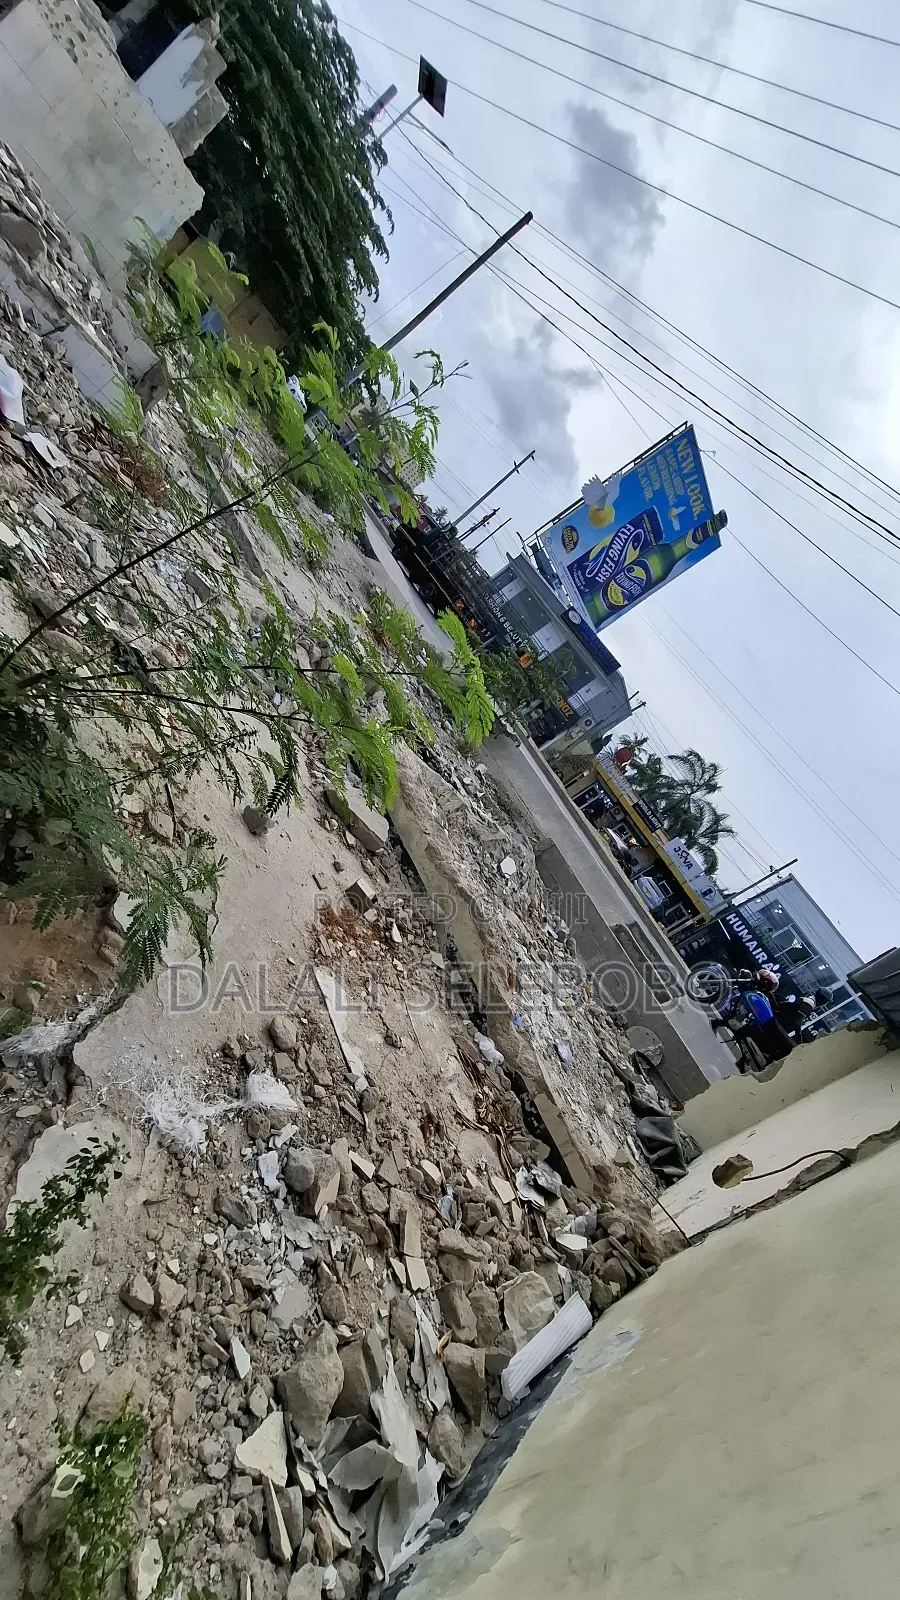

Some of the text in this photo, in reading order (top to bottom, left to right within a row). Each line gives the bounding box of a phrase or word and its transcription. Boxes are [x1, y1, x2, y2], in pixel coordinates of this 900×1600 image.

[646, 459, 660, 490] LEMON
[655, 454, 676, 505] REFRESHING
[664, 447, 684, 495] SAME CRISP
[674, 437, 706, 520] NEW LOOK.
[606, 522, 634, 558] FLYING
[595, 558, 618, 583] FISH
[615, 571, 633, 588] FLYING
[627, 583, 642, 596] FISH
[502, 620, 526, 648] BEAUTY
[637, 798, 661, 829] WORLD LIGHT
